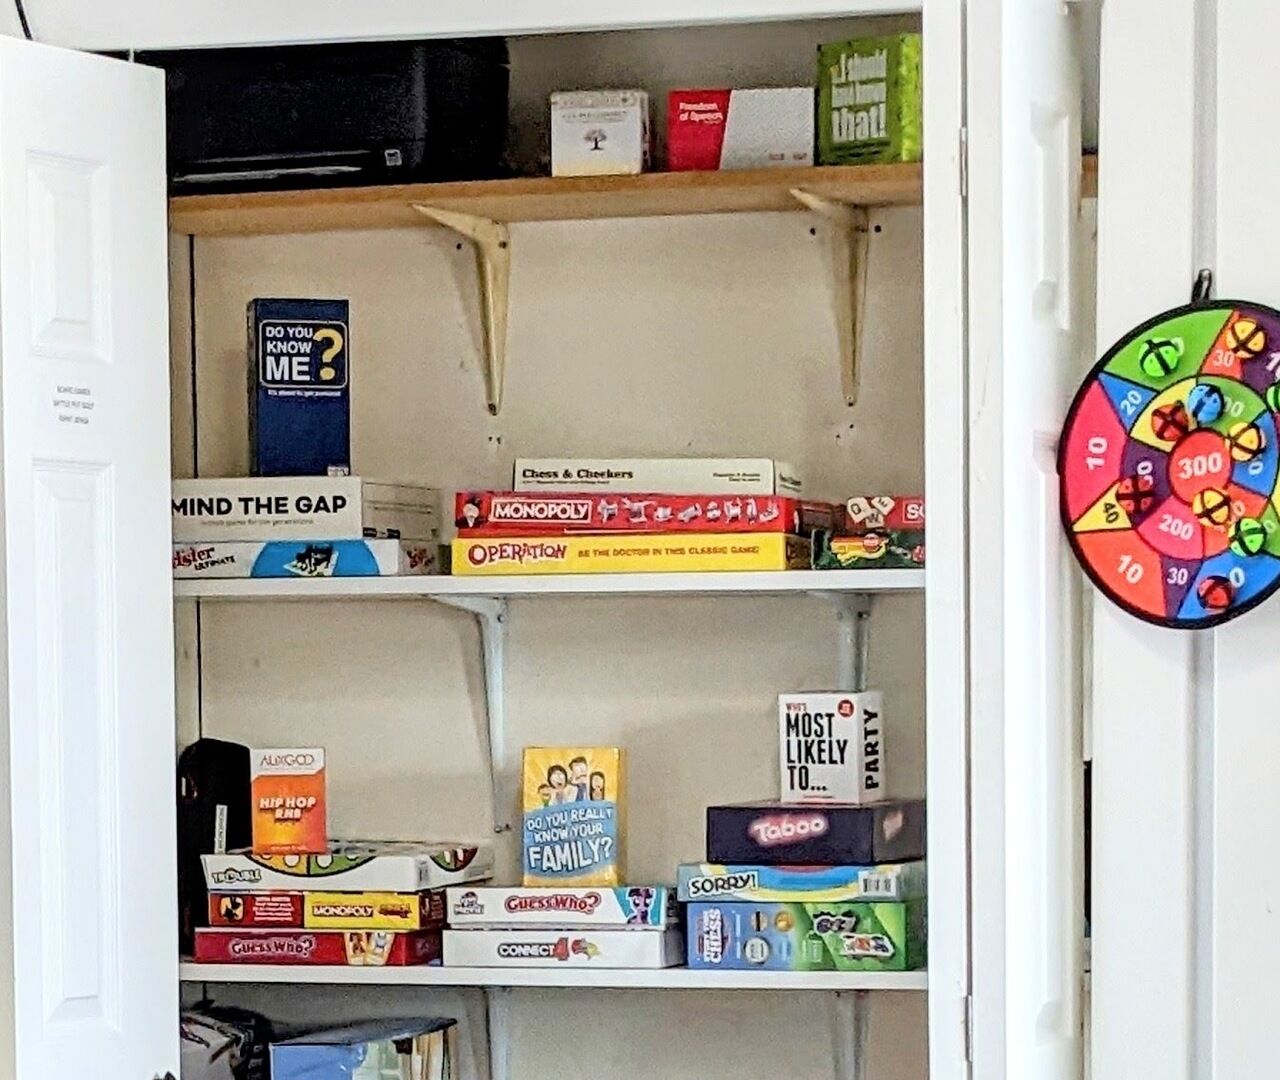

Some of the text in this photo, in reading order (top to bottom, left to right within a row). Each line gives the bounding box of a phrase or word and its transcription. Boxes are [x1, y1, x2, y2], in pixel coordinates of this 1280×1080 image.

[831, 103, 888, 142] that!
[265, 327, 314, 338] DO YOU
[266, 341, 312, 354] KNOW
[1212, 349, 1235, 367] 30
[266, 356, 310, 381] ME
[1121, 393, 1142, 416] 20
[1086, 436, 1108, 471] 10
[522, 468, 634, 480] Chess & Checkers
[1177, 451, 1223, 480] 300
[173, 495, 347, 516] MIND THE GAP
[494, 501, 589, 520] MONOPOLY
[1103, 502, 1119, 524] 40
[1158, 514, 1195, 541] 200
[467, 543, 568, 566] OPERATION
[593, 549, 609, 557] THE
[612, 548, 650, 557] DOCTOR
[652, 548, 662, 556] IN
[688, 546, 727, 555] CLASSIC
[1117, 554, 1144, 584] 10
[1166, 566, 1188, 585] 30
[785, 712, 835, 738] MOST
[786, 739, 848, 765] LIKELY
[863, 708, 879, 790] PARTY
[786, 765, 828, 791] TO...
[260, 796, 317, 809] HIP HOP
[526, 806, 614, 831] DO YOU REALLY
[755, 817, 826, 843] Taboo
[533, 822, 604, 844] KNOW YOUR
[528, 836, 613, 872] FAMILY?
[211, 867, 262, 884] TROUBLE
[690, 873, 757, 895] SORRY!
[313, 904, 373, 918] MONOPOLY
[498, 943, 555, 957] CONNECT
